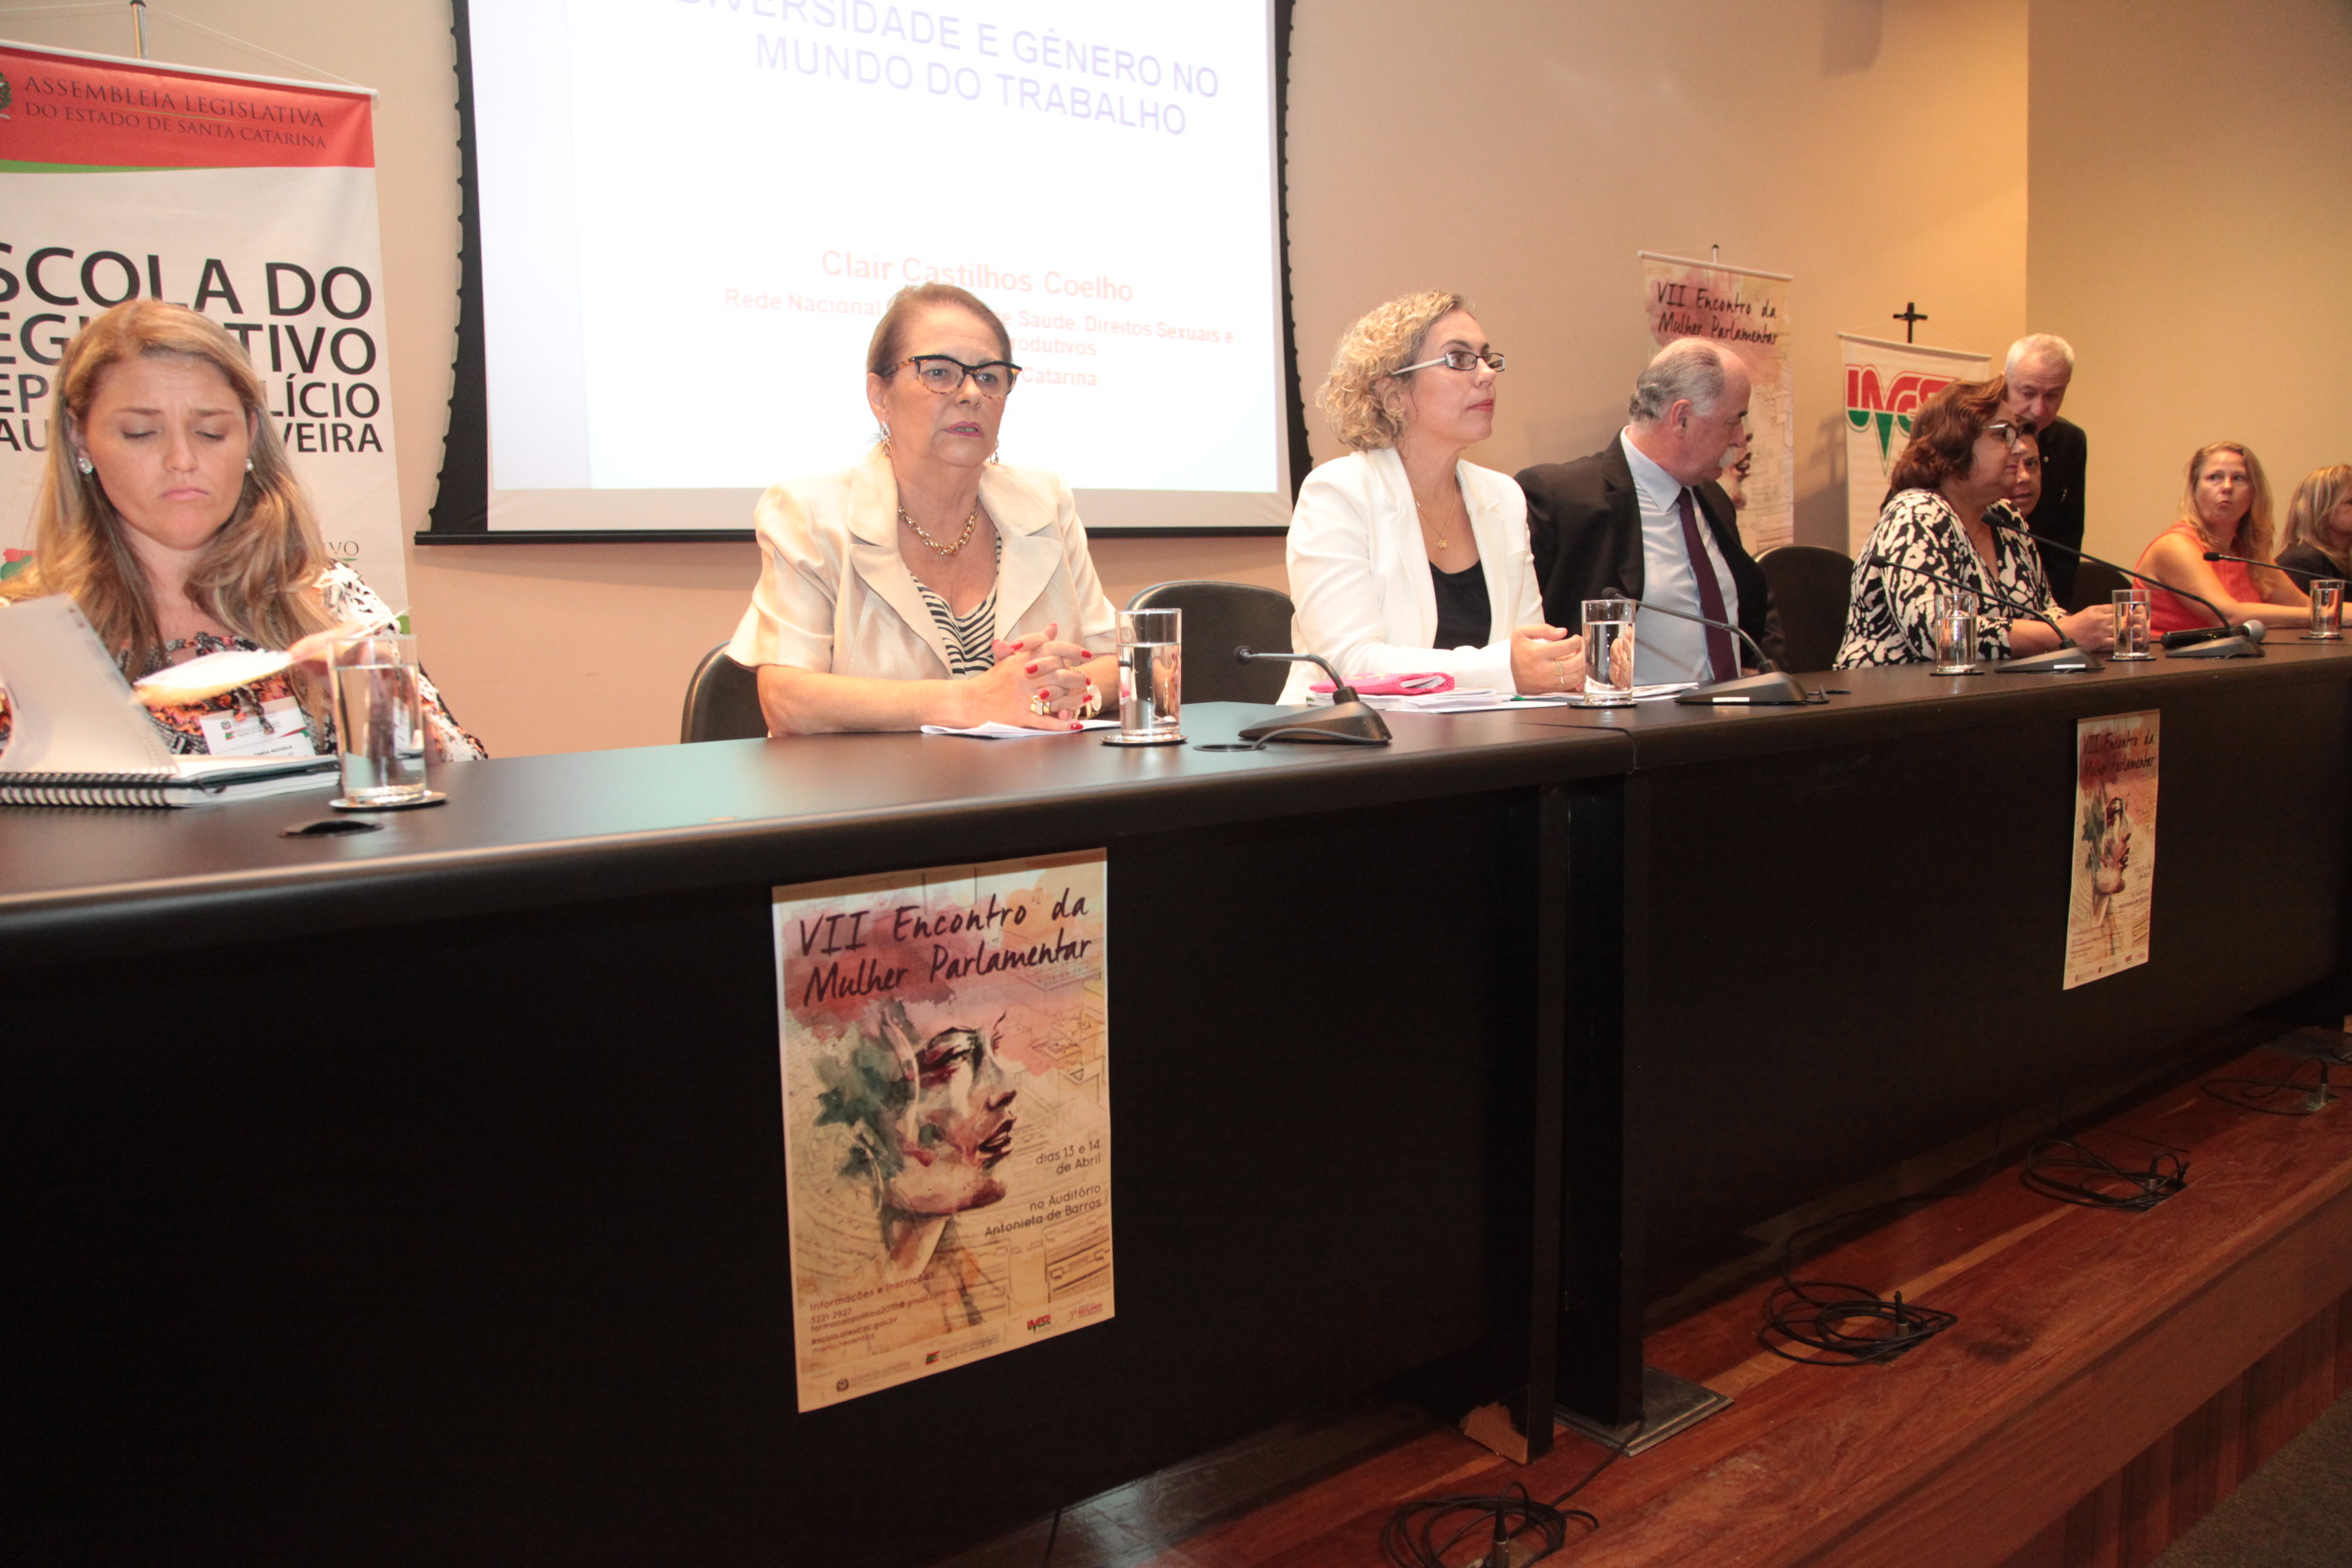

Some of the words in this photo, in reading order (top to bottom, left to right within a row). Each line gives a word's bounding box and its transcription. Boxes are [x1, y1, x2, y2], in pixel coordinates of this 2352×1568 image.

[676, 0, 961, 51] ERSIDADE
[978, 23, 999, 57] E
[1011, 27, 1162, 88] GÊNERO
[1173, 61, 1220, 99] NO
[25, 75, 176, 110] ASSEMBLEIA
[184, 94, 324, 128] LEGISLATIVA
[755, 32, 913, 91] MUNDO
[926, 62, 982, 101] DO
[994, 72, 1186, 136] TRABALHO
[25, 101, 57, 119] DO
[65, 106, 140, 128] ESTADO
[147, 116, 172, 132] DE
[177, 119, 235, 140] SANTA
[240, 127, 327, 150] CATARINA
[264, 262, 373, 321] DO
[820, 249, 893, 281] Clair
[901, 256, 1033, 293] Castilhos
[1043, 270, 1134, 302] Coelho
[1658, 280, 1688, 308] VII
[1696, 286, 1752, 315] Encontro
[1761, 298, 1777, 318] da
[724, 287, 781, 310] Rede
[787, 291, 882, 317] Nacional
[1085, 314, 1152, 337] Direitos
[1156, 321, 1221, 344] Sexuais
[1223, 330, 1234, 344] e
[1658, 311, 1703, 336] Mulher
[1712, 314, 1779, 346] Parlamentar
[1021, 365, 1098, 387] Catarina
[799, 910, 870, 957] VII
[893, 892, 1026, 943] Encontro
[1050, 886, 1090, 923] da
[803, 958, 909, 1009] Mulher
[928, 927, 1092, 983] Parlamentar
[1035, 1151, 1061, 1166] dias
[1063, 1145, 1075, 1159] 13
[1078, 1146, 1086, 1155] e
[1089, 1138, 1101, 1152] 14
[1056, 1162, 1071, 1175] de
[1074, 1153, 1102, 1170] Abril
[984, 1214, 1044, 1239] Antonieta
[1046, 1210, 1062, 1222] de
[1064, 1198, 1102, 1217] Barros
[1029, 1200, 1044, 1211] no
[1048, 1184, 1102, 1208] Auditório
